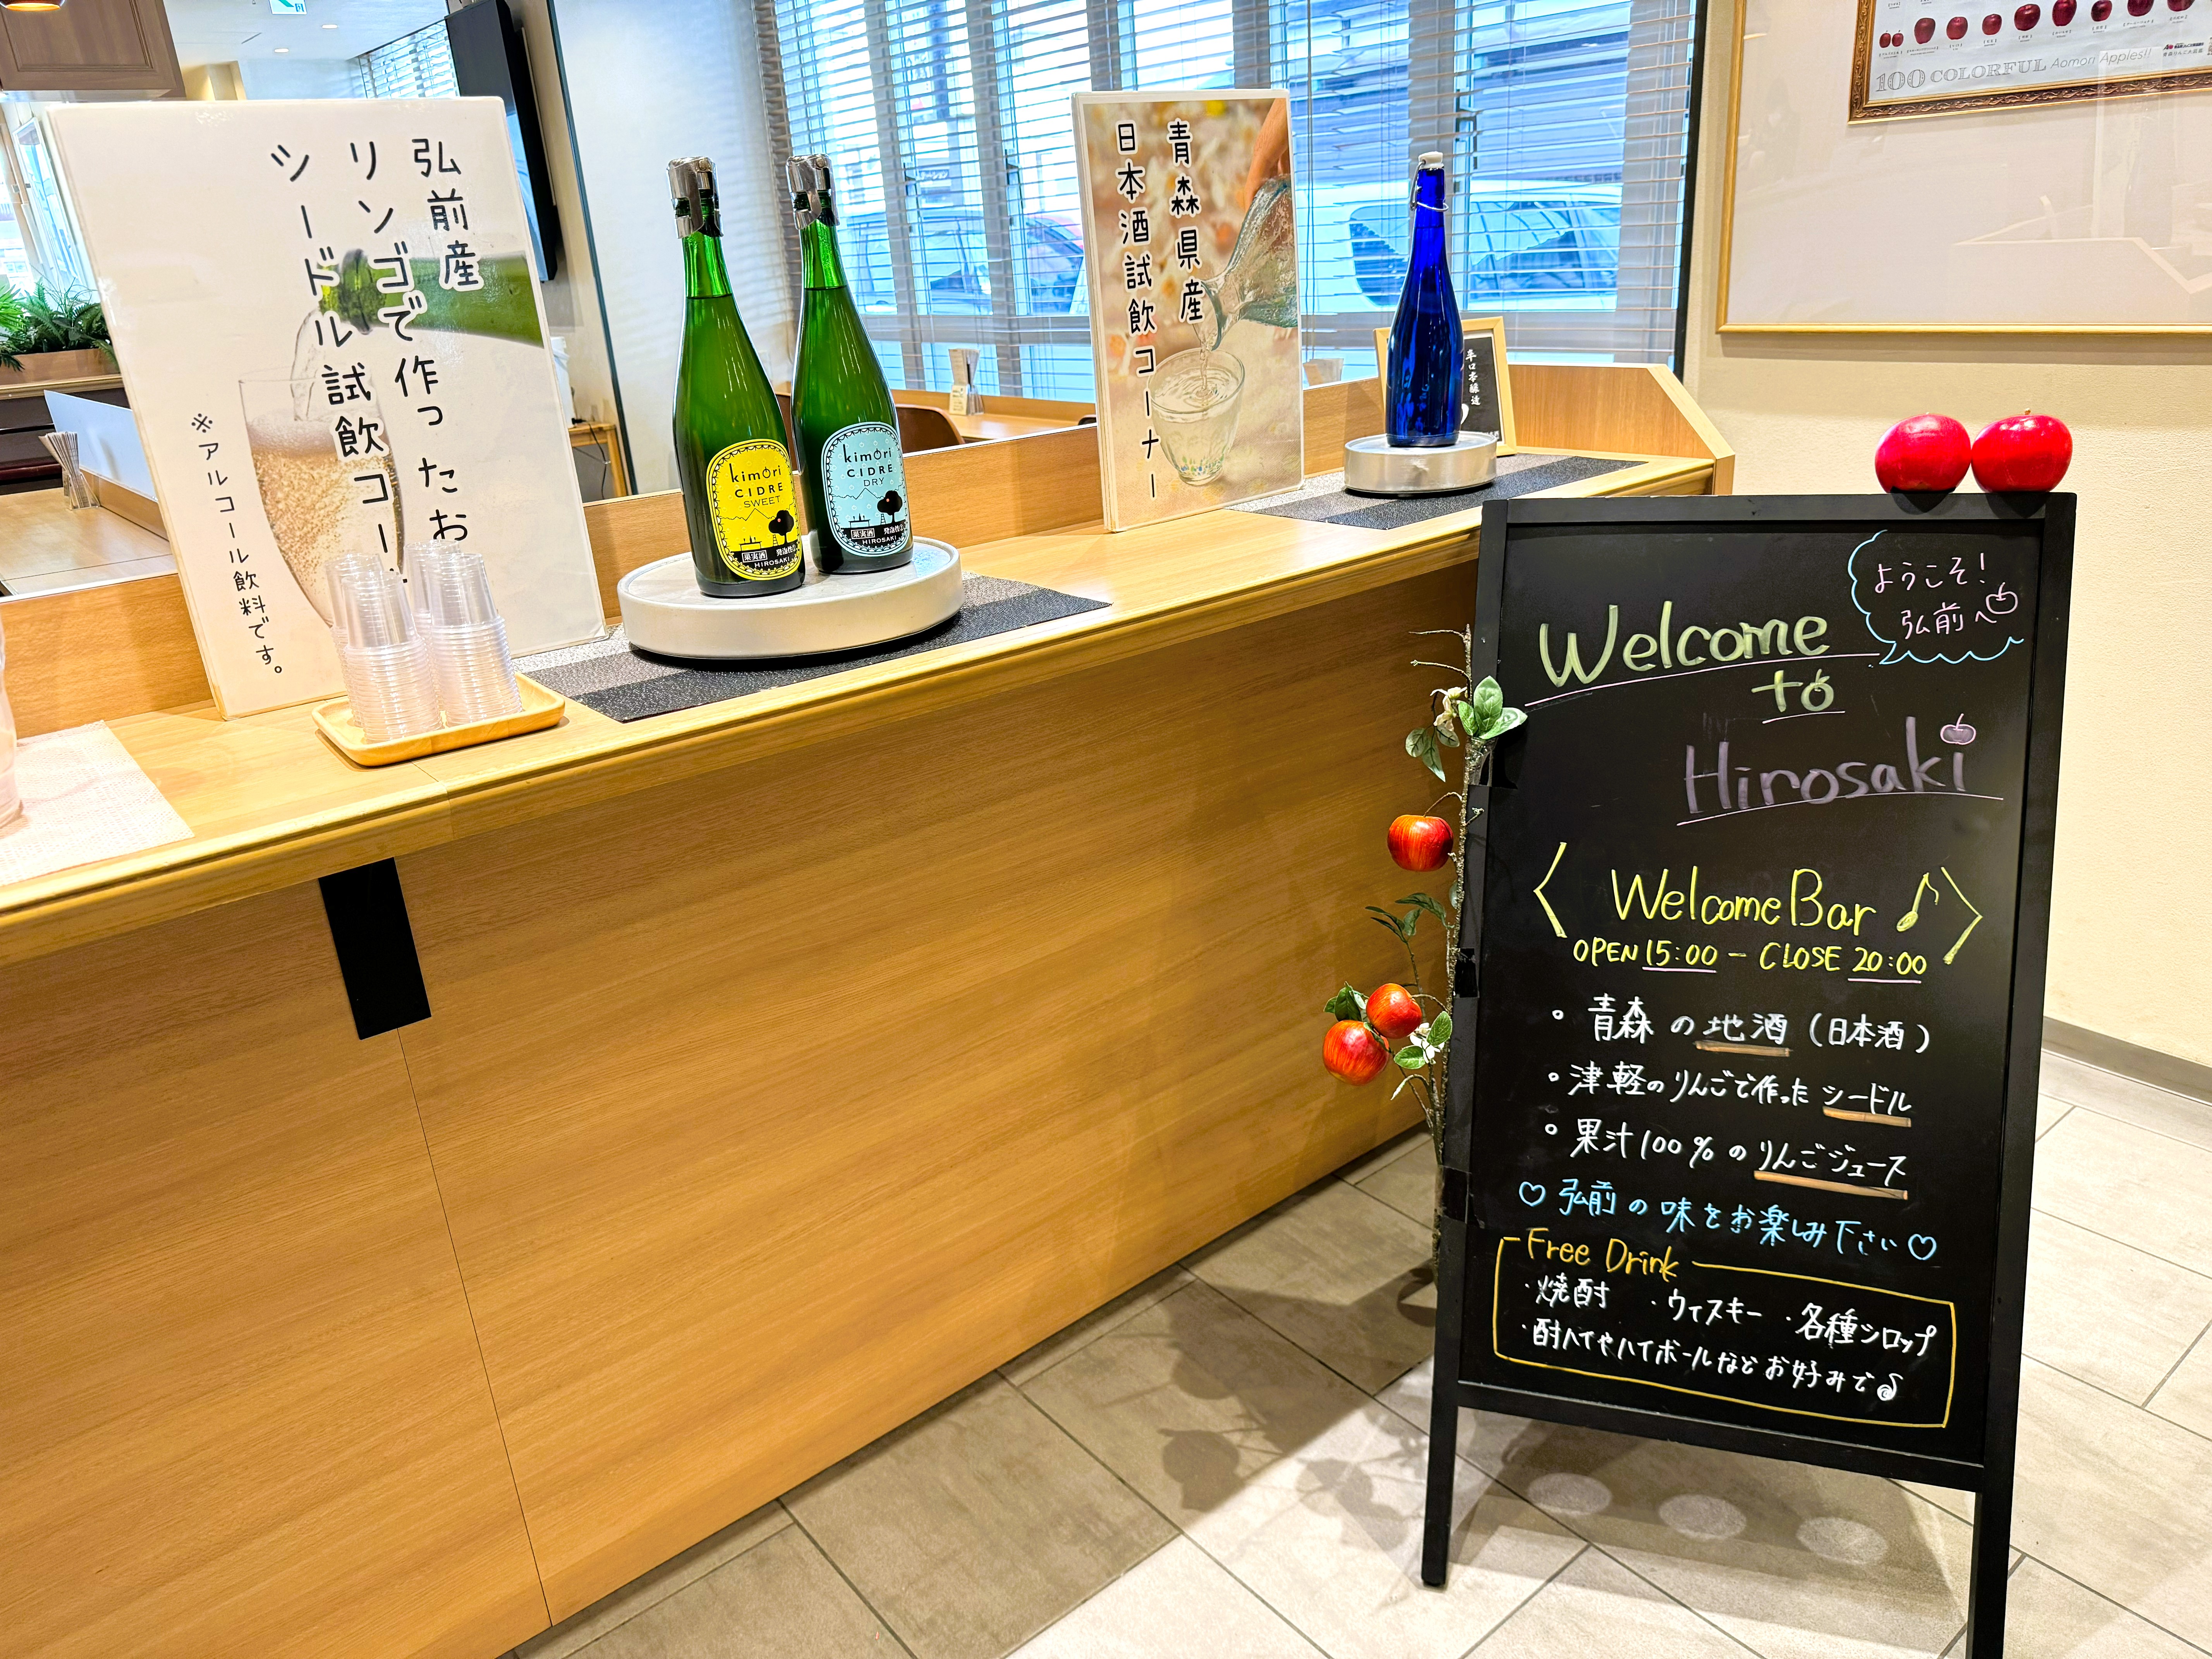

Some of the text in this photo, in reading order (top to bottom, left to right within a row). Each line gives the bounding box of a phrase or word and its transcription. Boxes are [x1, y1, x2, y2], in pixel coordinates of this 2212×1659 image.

[1876, 48, 2152, 92] 100 COLORFUL Aomori Apples!!
[414, 139, 478, 285] 弘前産
[1170, 122, 1202, 320] 青森県産
[1118, 124, 1158, 497] 日本酒試飲コーナー
[272, 146, 407, 583] シードル試飲コー
[843, 444, 891, 463] kimori
[847, 464, 893, 477] CIDRE
[729, 463, 781, 483] kimori
[735, 483, 783, 498] CIDRE
[864, 477, 884, 486] DRY
[744, 496, 780, 508] SWEET
[853, 529, 874, 538] 果実酒
[862, 536, 896, 545] HIROSAKI
[744, 552, 766, 561] 果実酒
[754, 556, 790, 568] HIROSAKI
[1901, 602, 1997, 639] 弘前へ
[1540, 601, 1830, 687] Welcome
[1752, 669, 1834, 712] to
[1683, 716, 1966, 814] Hirosaki
[1573, 937, 1639, 967] OPEN
[1646, 939, 1718, 966] 15:00
[1759, 942, 1842, 971] CLOSE
[1852, 947, 1927, 975] 20:00
[1527, 1228, 1679, 1283] Free Drink
[1795, 1303, 1937, 1356] 各種シロップ
